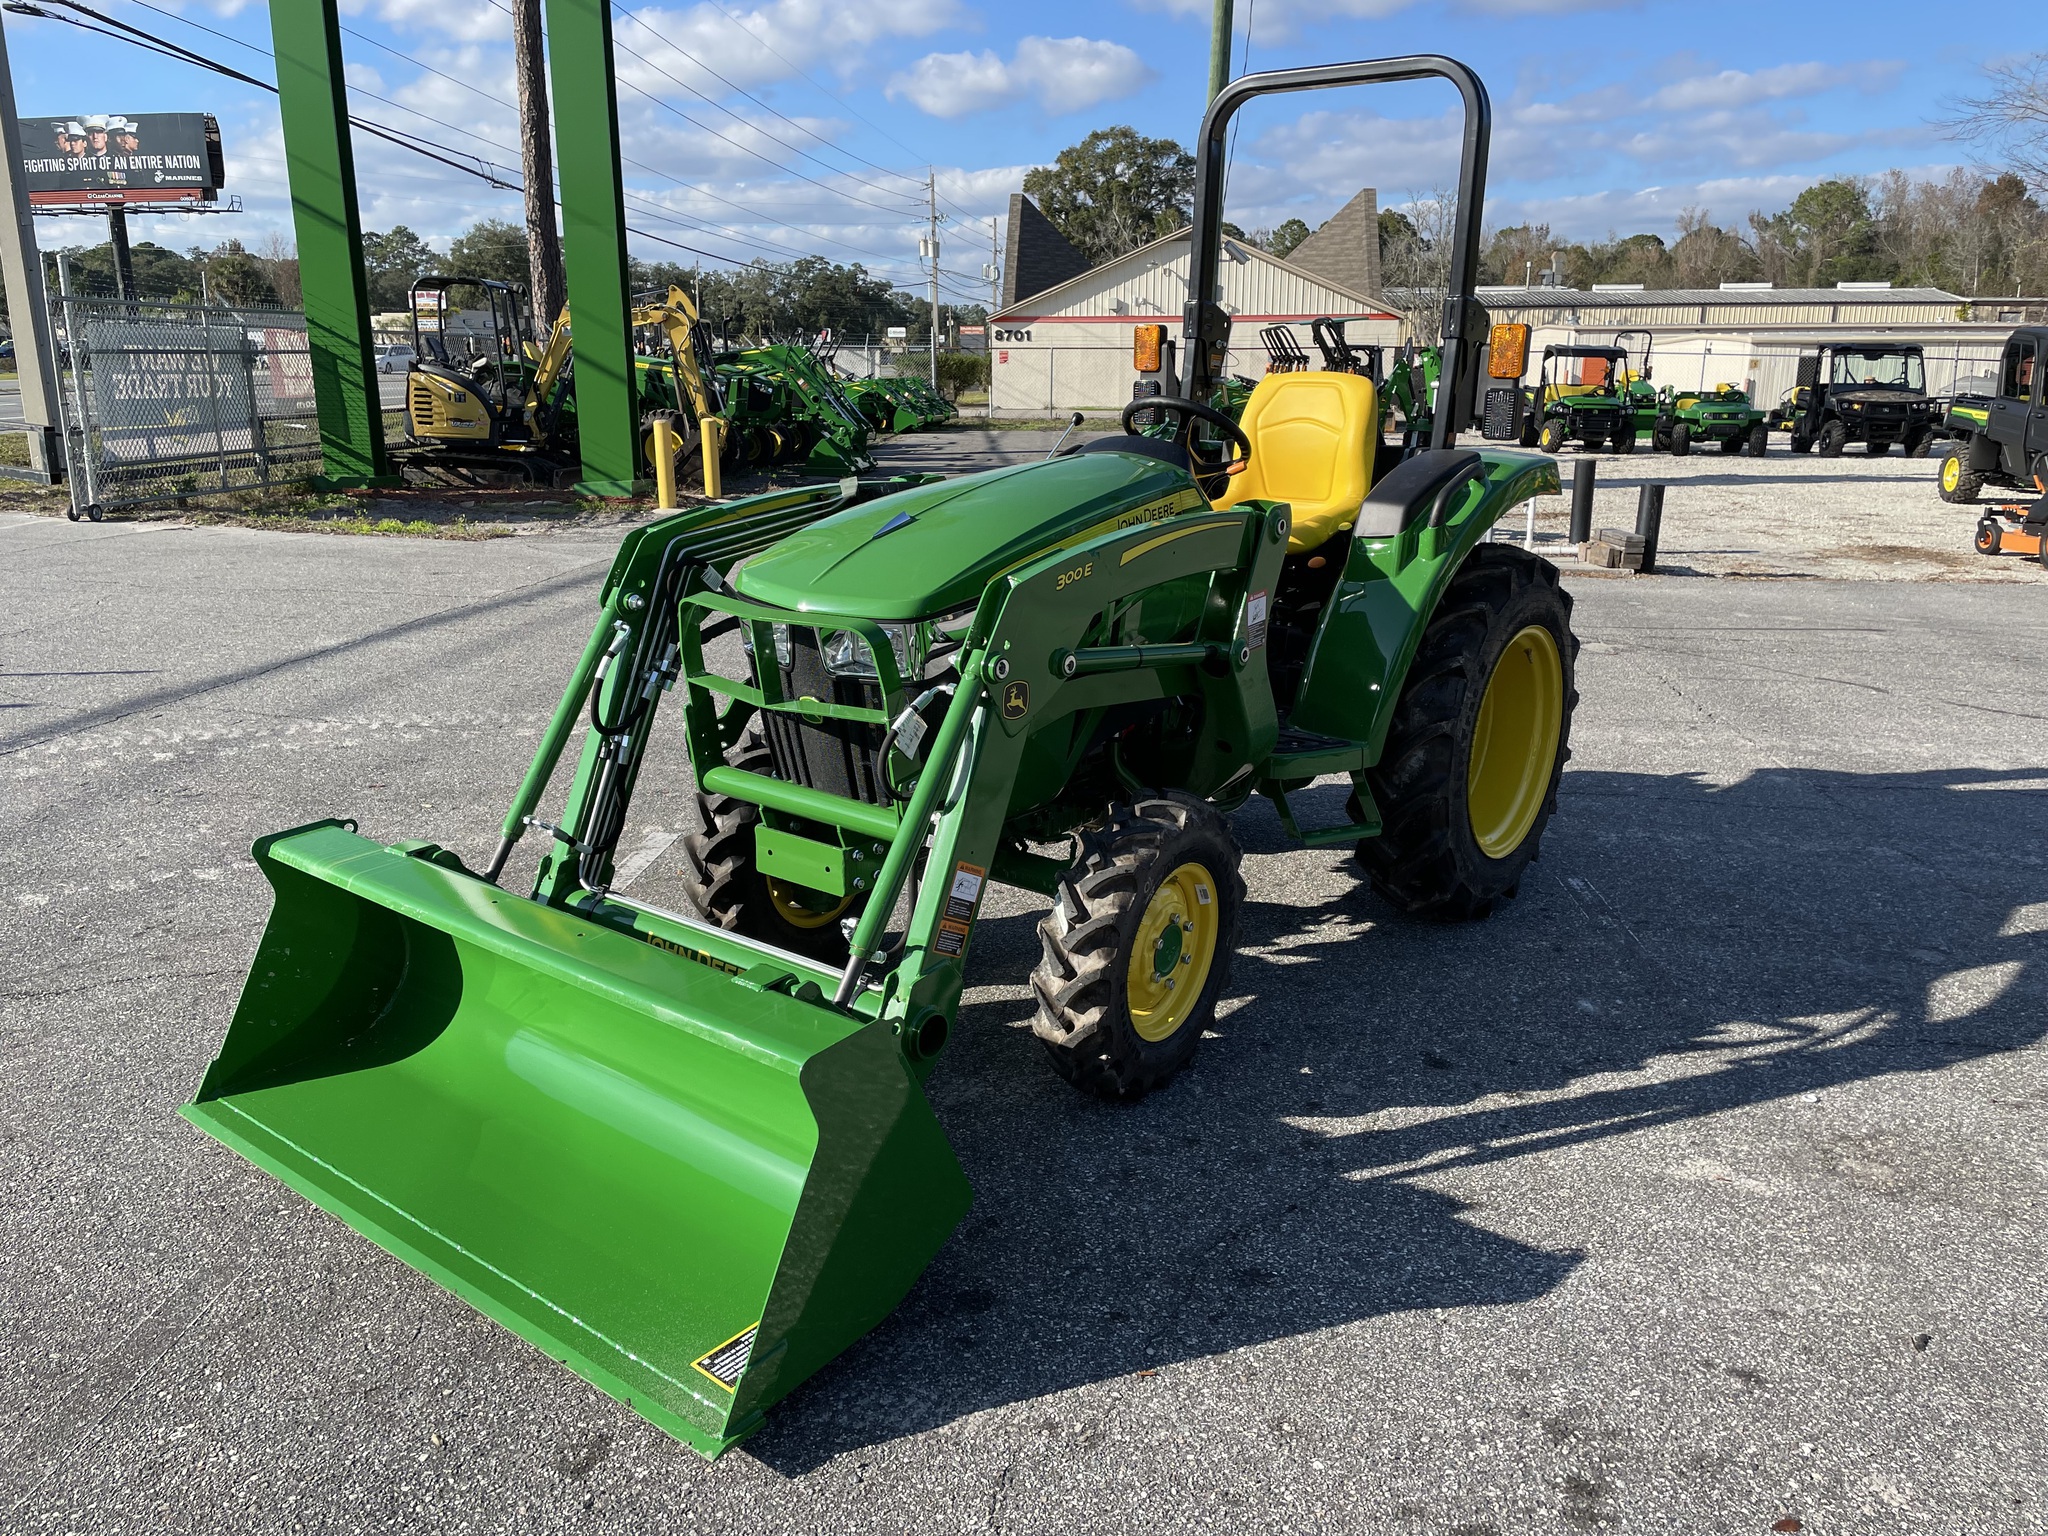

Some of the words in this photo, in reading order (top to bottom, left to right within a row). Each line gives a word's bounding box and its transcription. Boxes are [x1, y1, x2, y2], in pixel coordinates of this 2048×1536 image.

[24, 158, 66, 173] FIGHTING
[67, 157, 97, 171] SPIRIT
[99, 156, 111, 170] OF
[114, 156, 128, 170] AN
[129, 155, 163, 169] ENTIRE
[165, 154, 201, 169] NATION
[995, 330, 1032, 342] 8701
[1117, 513, 1143, 531] JOHN
[1144, 502, 1175, 523] DEERE
